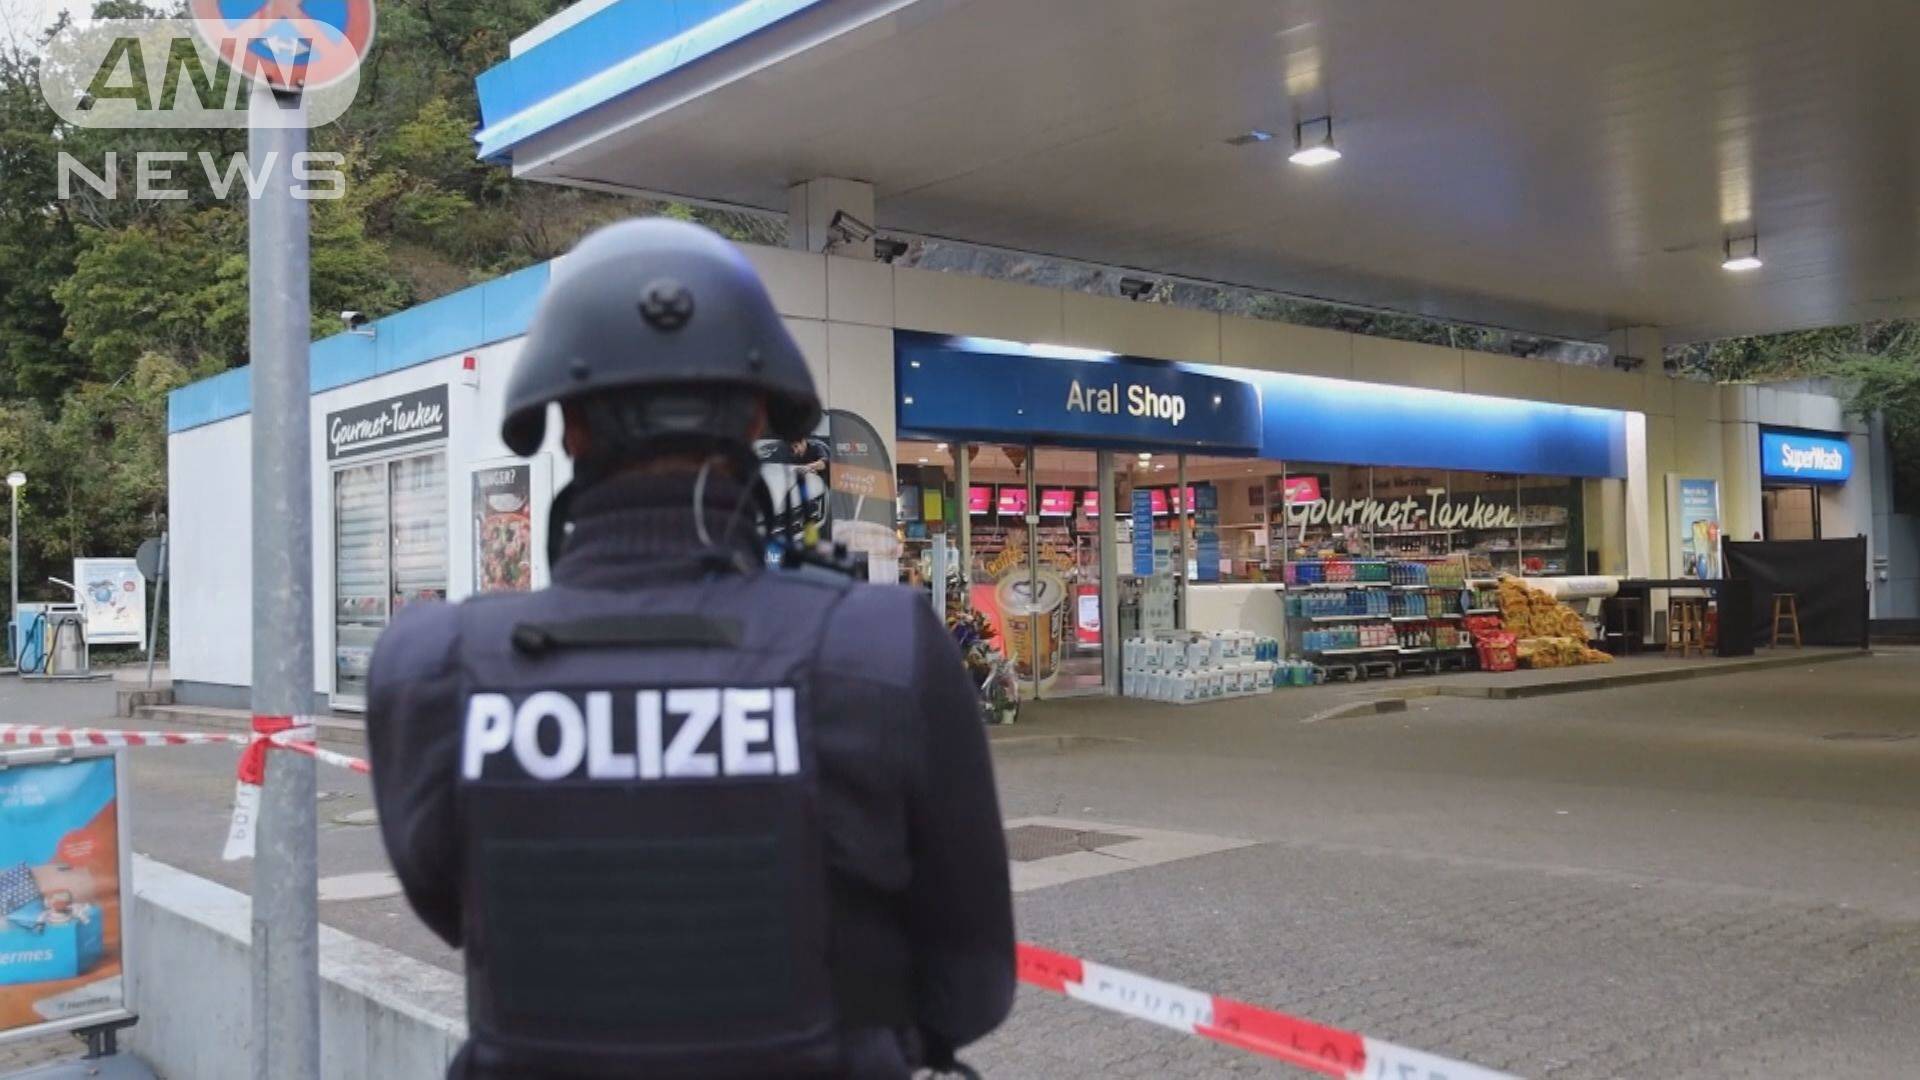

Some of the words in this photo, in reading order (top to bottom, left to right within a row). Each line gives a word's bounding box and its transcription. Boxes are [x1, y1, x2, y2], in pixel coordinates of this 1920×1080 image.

[330, 400, 444, 456] Gourmet-Tanken
[1066, 379, 1119, 415] Aral
[1127, 384, 1186, 426] Shop
[1781, 442, 1843, 473] SuperWash
[1286, 480, 1517, 544] Gourmet-Tanken
[462, 686, 801, 780] POLIZEI
